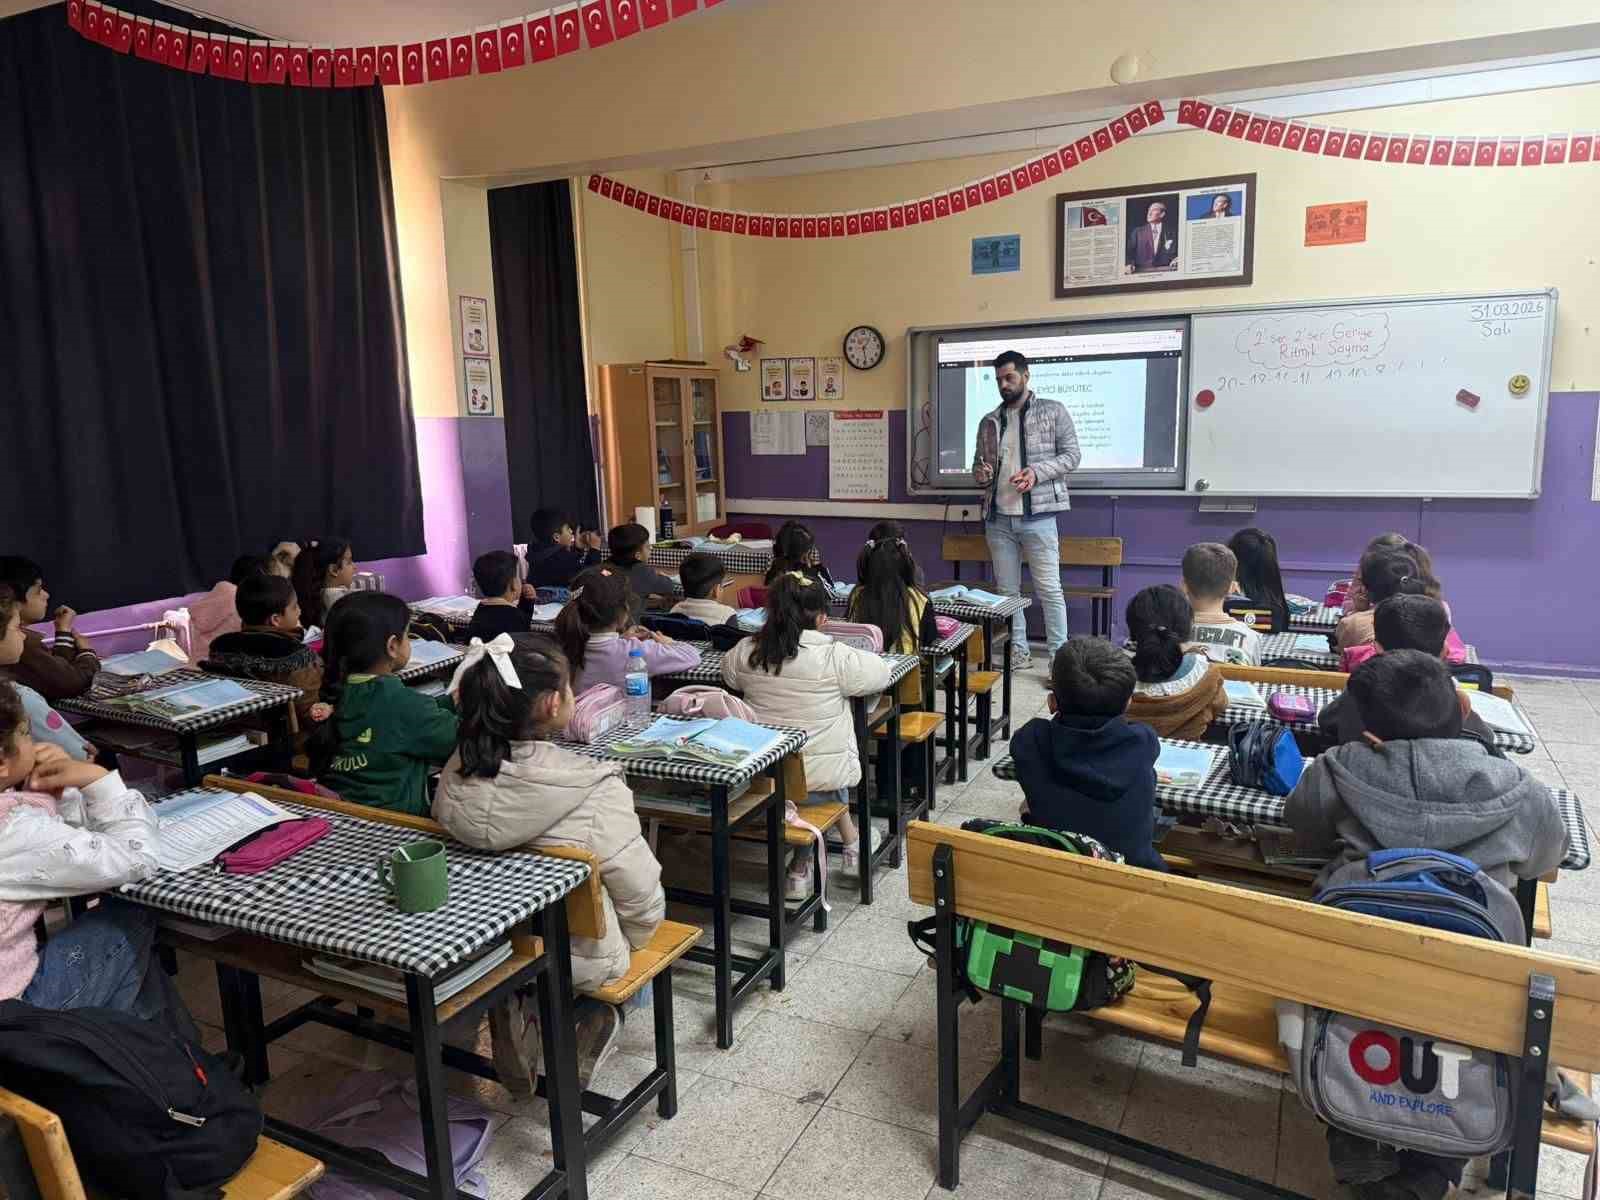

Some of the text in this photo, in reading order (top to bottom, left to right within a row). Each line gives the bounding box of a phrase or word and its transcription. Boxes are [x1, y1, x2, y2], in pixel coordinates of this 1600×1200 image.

[1348, 1030, 1472, 1099] OUT
[1369, 1090, 1455, 1114] AND EXPLORE
